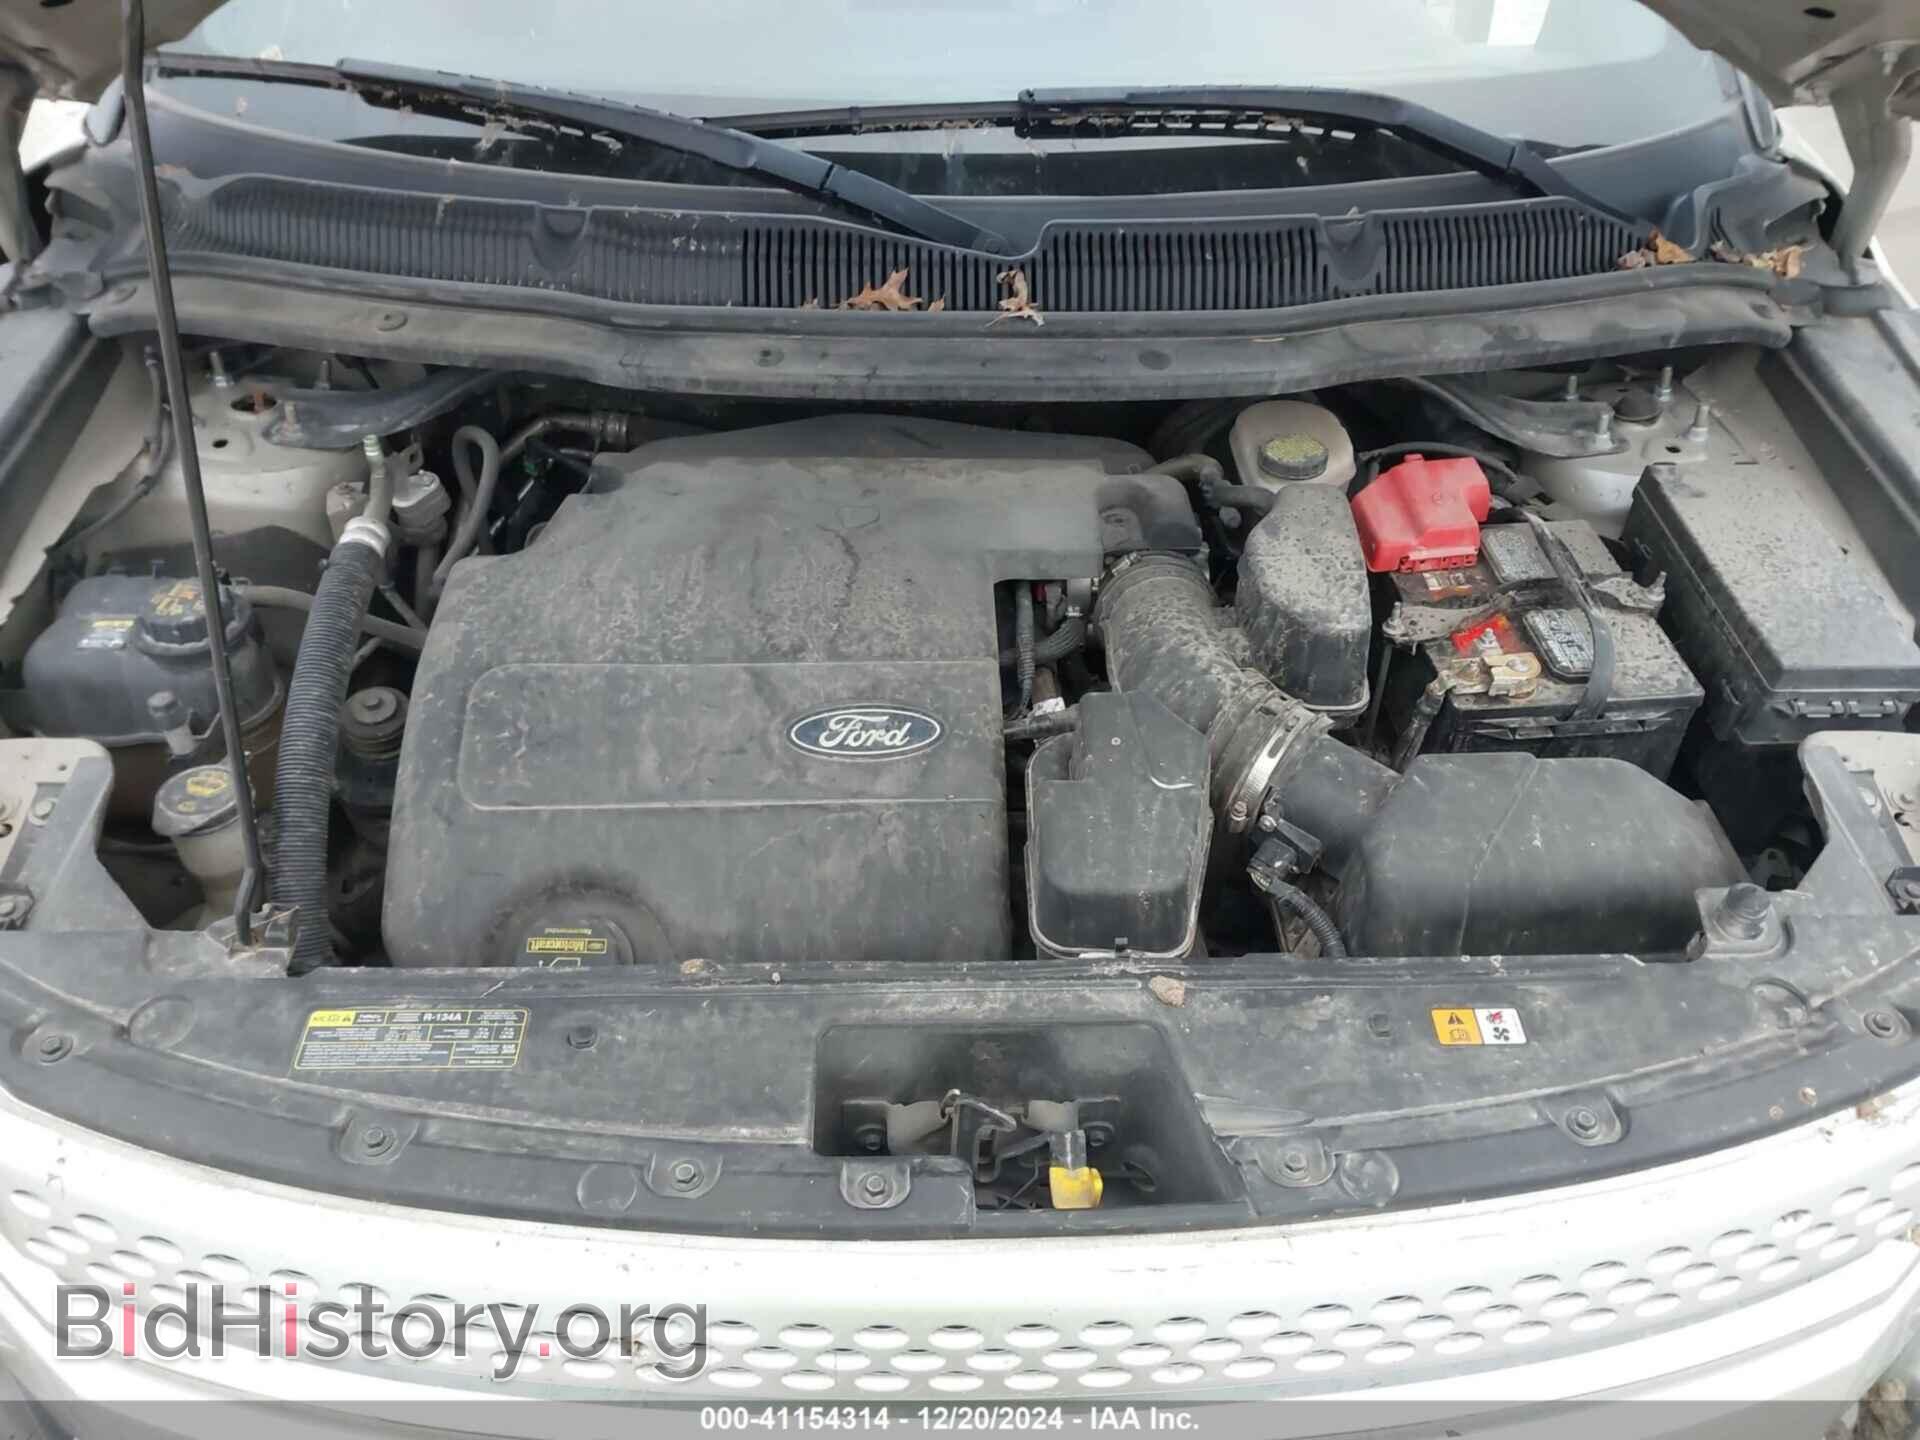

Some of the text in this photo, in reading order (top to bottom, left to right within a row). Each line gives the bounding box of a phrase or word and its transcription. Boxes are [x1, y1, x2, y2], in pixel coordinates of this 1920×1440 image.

[818, 714, 912, 748] Ford
[531, 940, 585, 952] Motorcraft
[422, 1012, 462, 1022] R-134A
